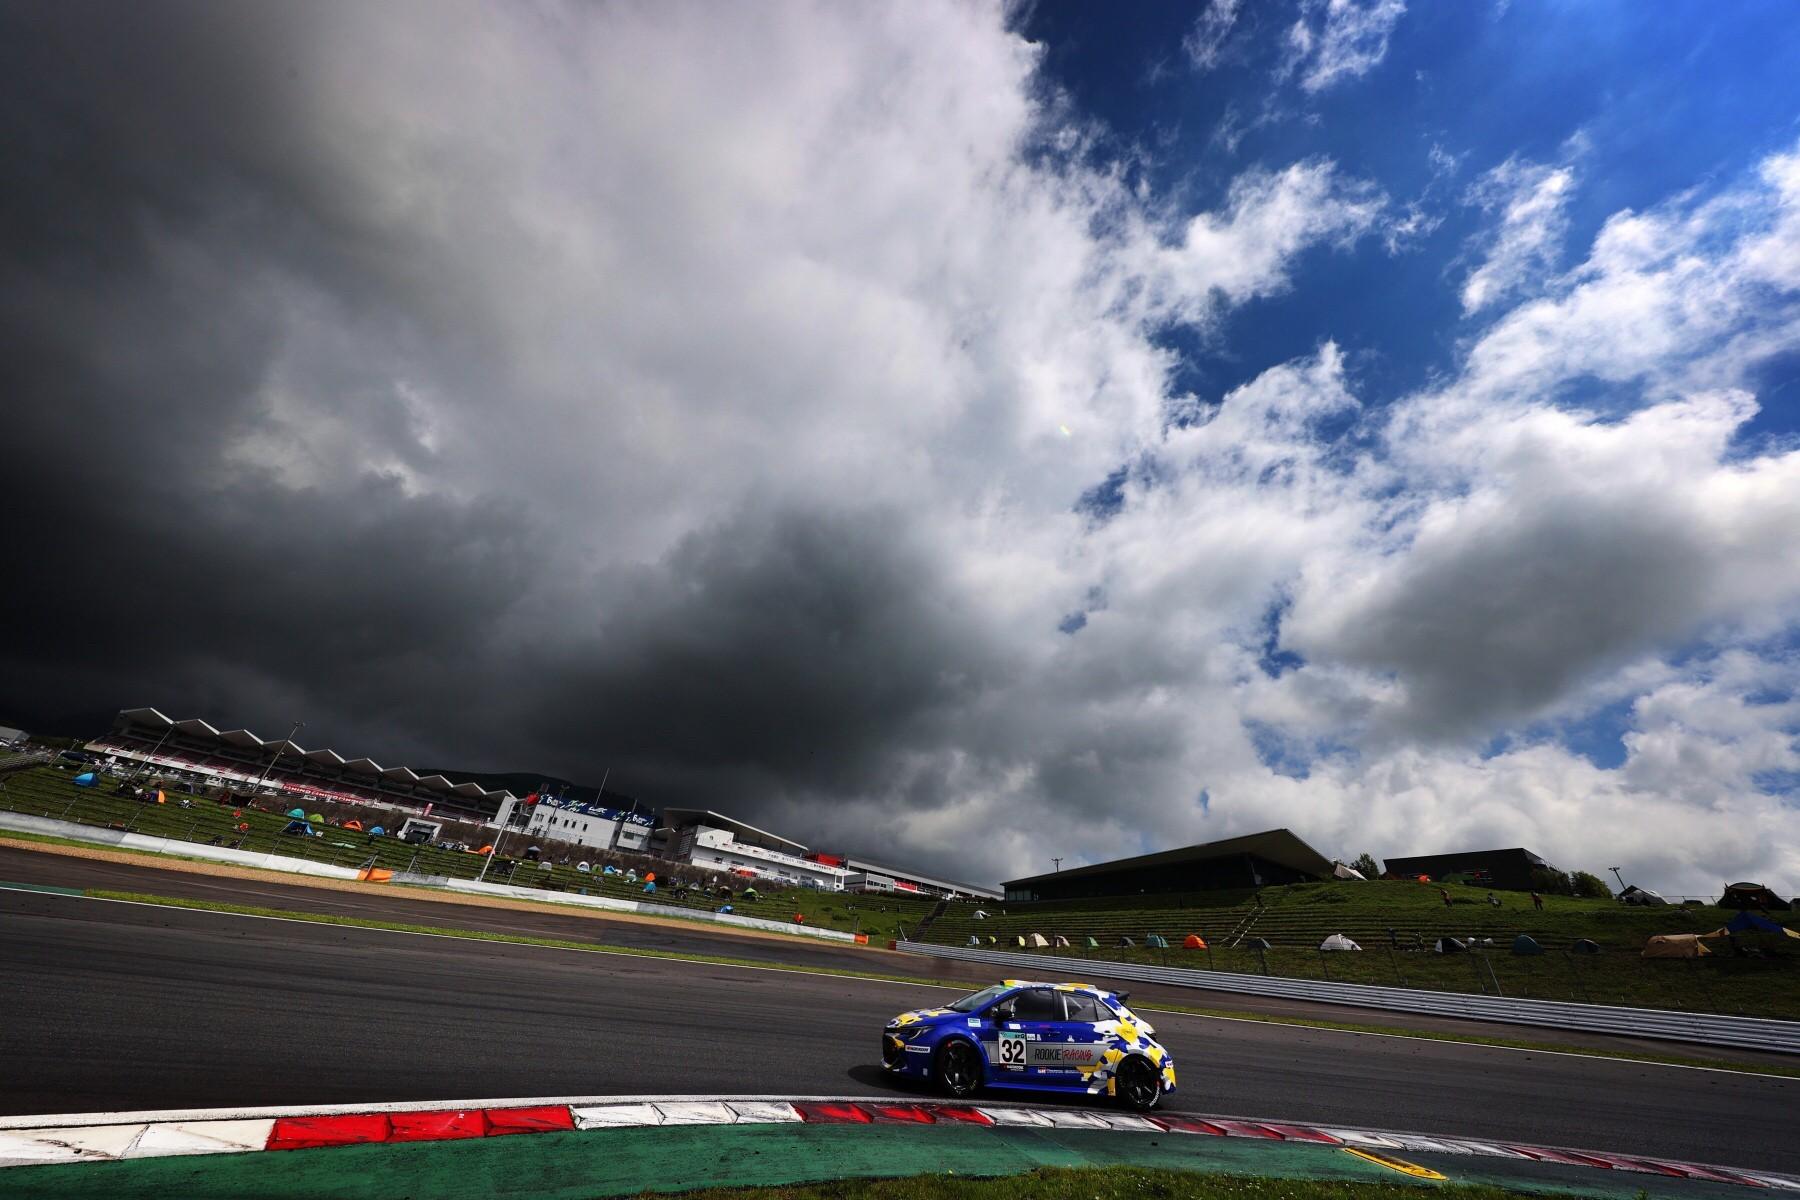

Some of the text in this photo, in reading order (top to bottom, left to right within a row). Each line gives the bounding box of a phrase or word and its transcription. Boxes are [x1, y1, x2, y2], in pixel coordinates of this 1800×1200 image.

[1001, 1039, 1025, 1063] 32
[1034, 1048, 1093, 1061] ROOKIE RACING
